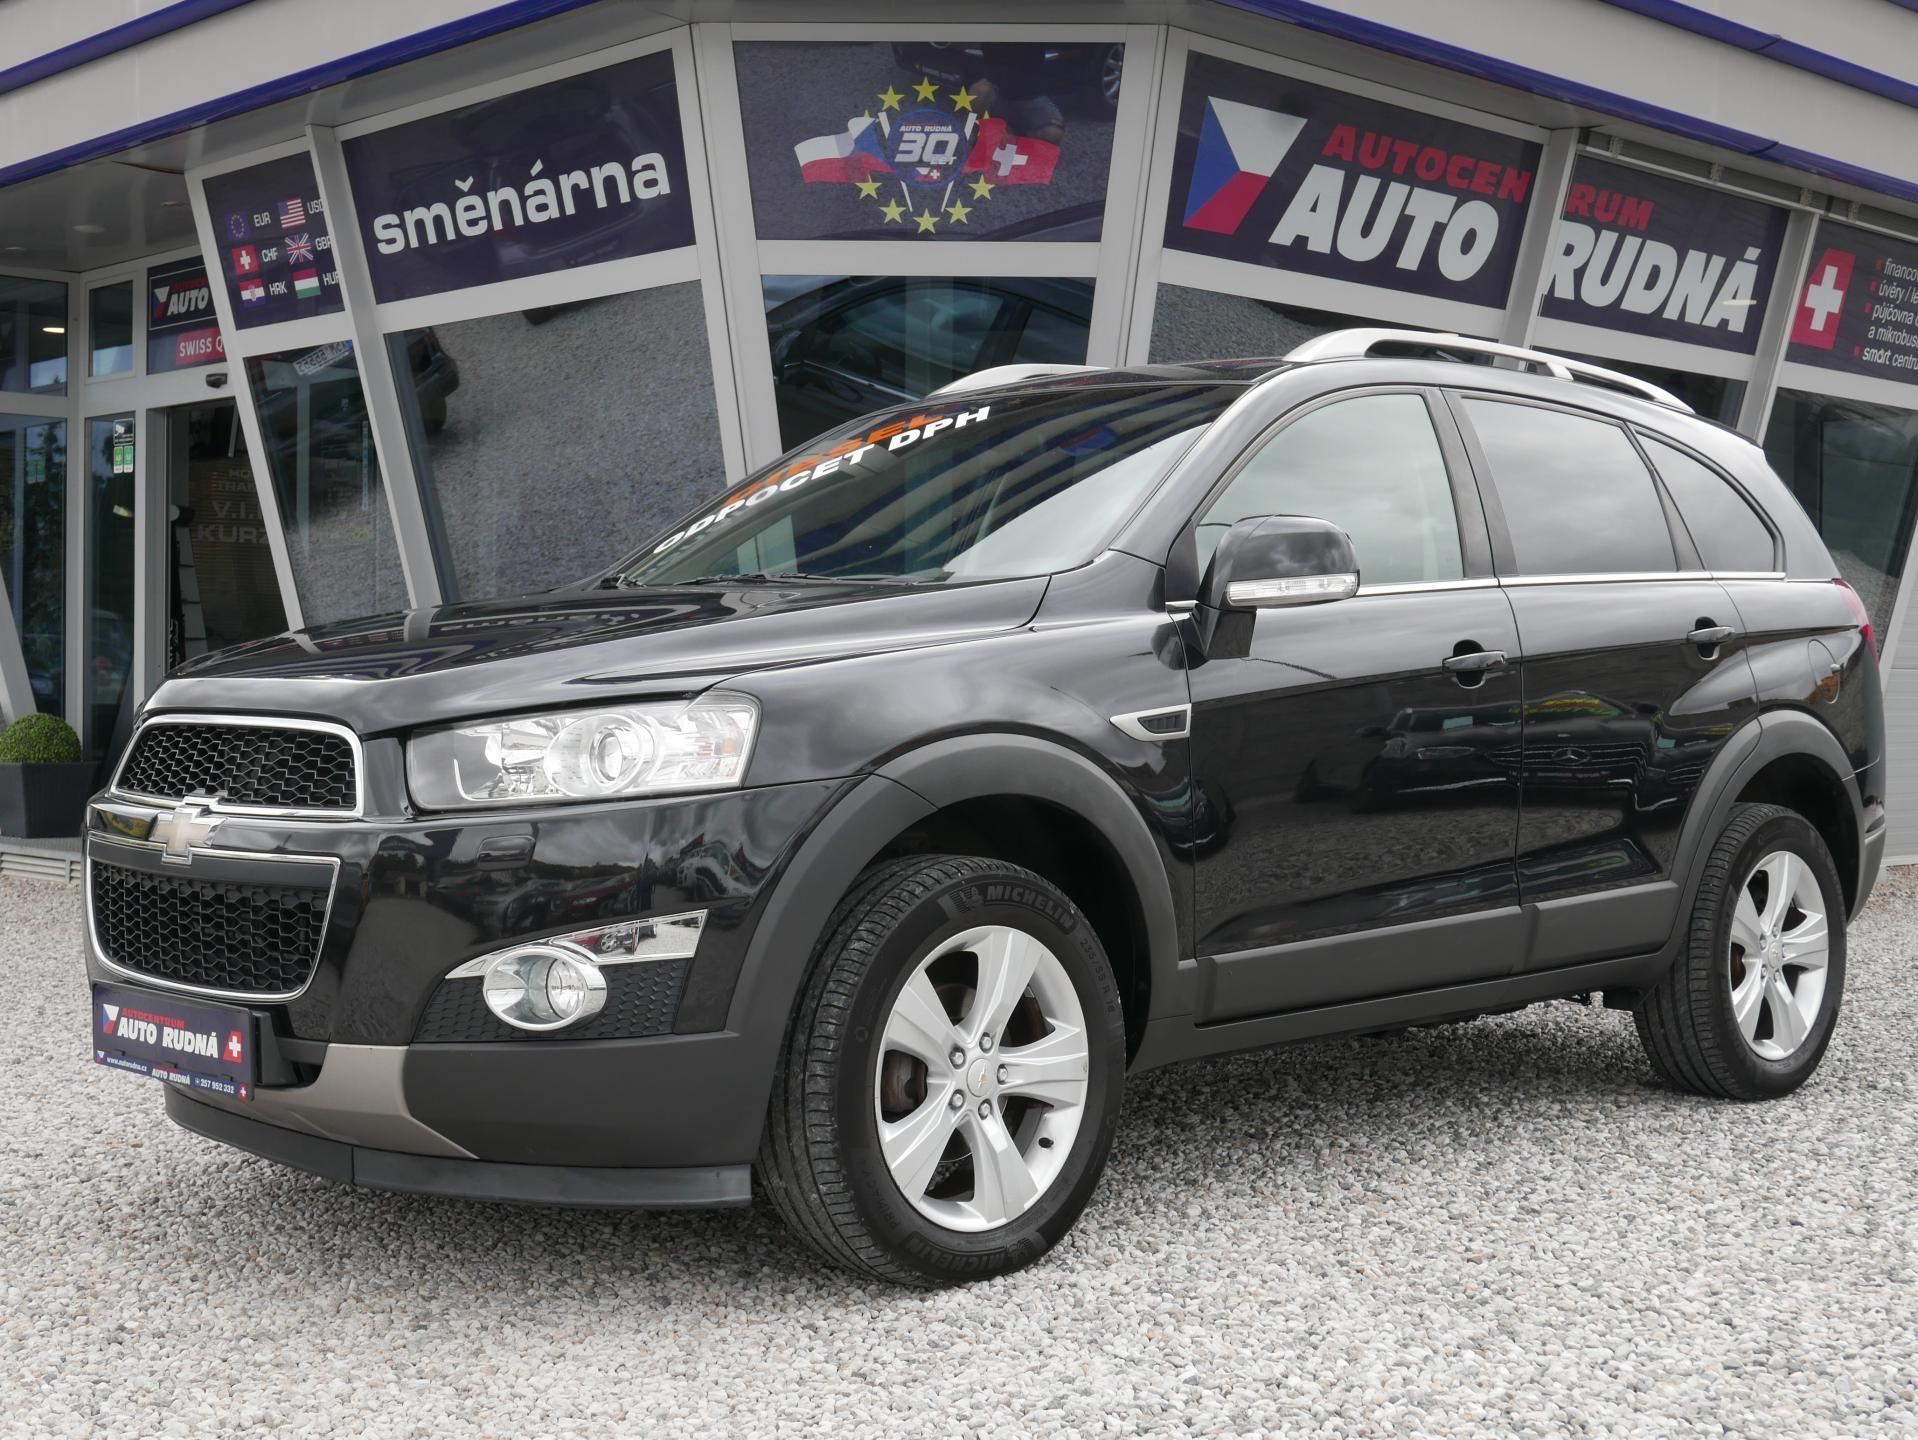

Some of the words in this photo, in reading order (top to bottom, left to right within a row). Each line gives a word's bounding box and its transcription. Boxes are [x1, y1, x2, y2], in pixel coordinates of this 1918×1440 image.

[895, 133, 960, 162] 30
[373, 152, 671, 255] směnárna
[253, 212, 272, 227] EUR
[261, 247, 279, 263] CHF
[1267, 164, 1499, 282] AUTO
[1544, 219, 1762, 333] RUDNÁ
[269, 280, 288, 296] HRK
[1878, 280, 1905, 304] úvěry
[167, 287, 210, 316] AUTO
[1867, 325, 1875, 339] a
[179, 337, 213, 357] SWISS
[888, 405, 991, 451] DPH
[986, 885, 1075, 930] MICHELIN
[121, 1007, 186, 1029] AUTOCENTRUM
[117, 1016, 158, 1045] AUTO
[162, 1026, 219, 1059] RUDNÁ
[151, 1068, 168, 1080] AUTO
[169, 1072, 191, 1085] RUDNÁ
